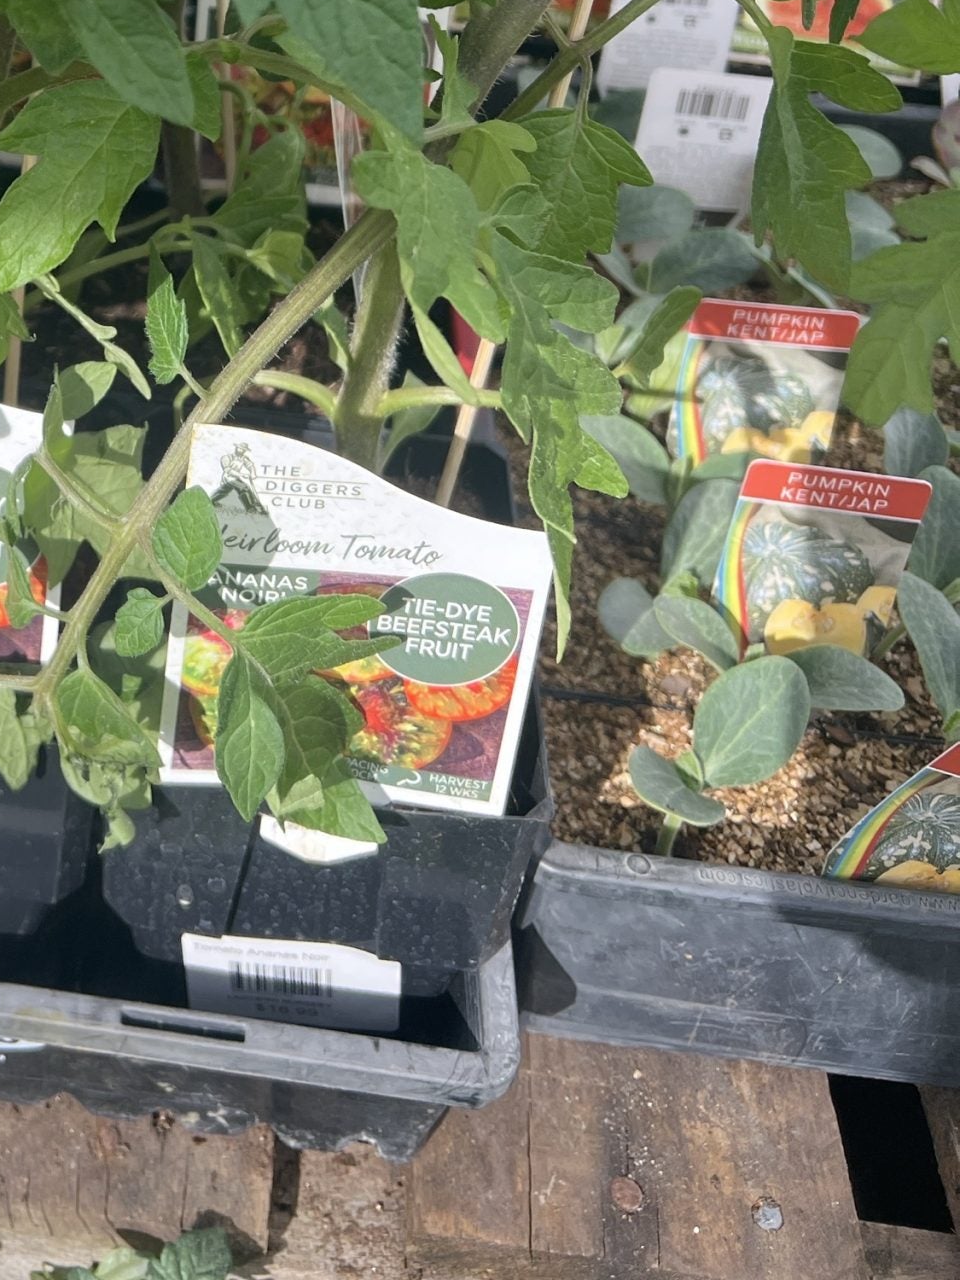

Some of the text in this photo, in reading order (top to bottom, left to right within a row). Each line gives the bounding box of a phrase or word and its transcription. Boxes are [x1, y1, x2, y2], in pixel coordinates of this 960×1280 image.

[733, 308, 825, 330] PUMPKIN
[727, 323, 824, 342] KENT/JAP
[260, 464, 301, 477] THE
[265, 481, 362, 497] DIGGERS
[787, 471, 891, 498] PUMPKIN
[271, 496, 327, 510] CLUB
[780, 488, 889, 511] KENT/JAP
[221, 524, 442, 566] eirloom Tomato
[402, 597, 492, 621] TIE-DYE
[376, 614, 511, 646] BEEFSTEAK
[404, 638, 474, 661] FRUIT
[429, 773, 489, 790] HARVEST
[435, 784, 479, 799] 12 WKS
